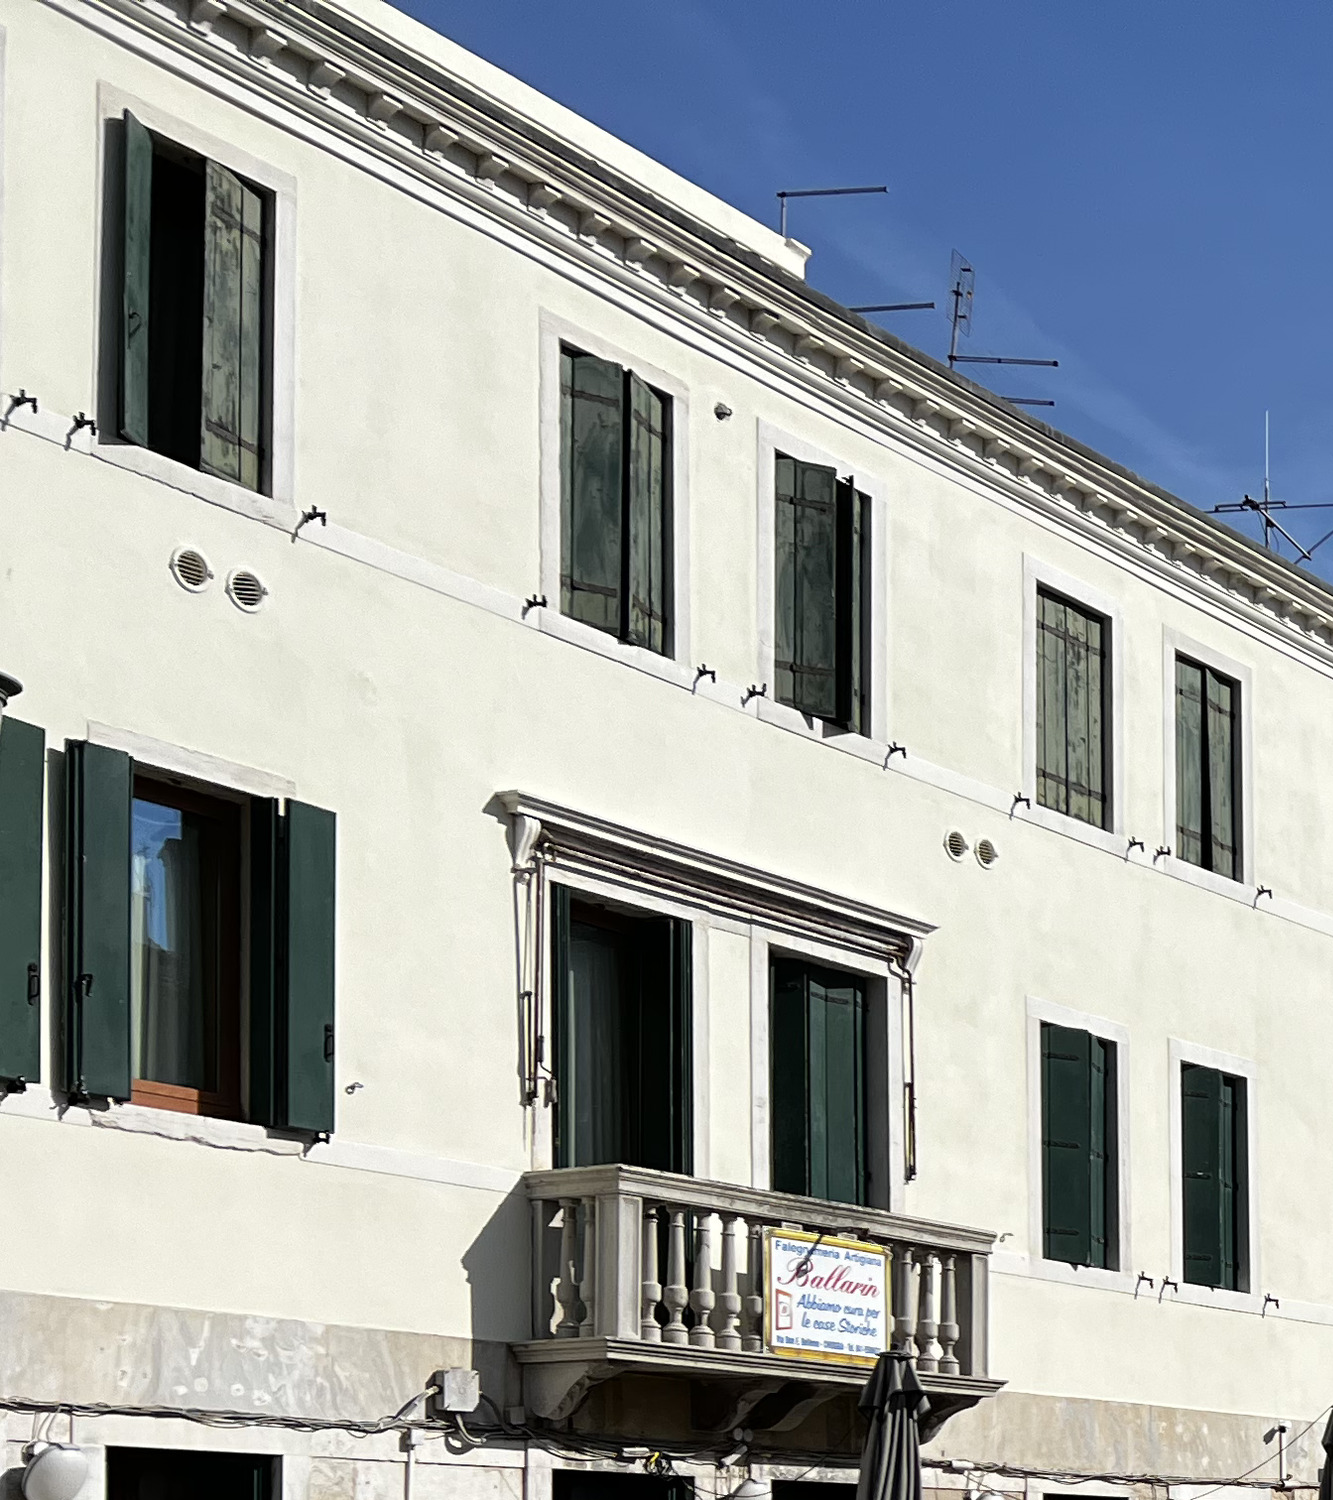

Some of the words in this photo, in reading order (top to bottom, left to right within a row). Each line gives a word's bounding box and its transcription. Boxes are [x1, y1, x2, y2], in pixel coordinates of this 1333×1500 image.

[844, 1250, 882, 1267] Artigiana
[777, 1256, 880, 1298] Ballarin
[797, 1293, 841, 1313] Abbiamo
